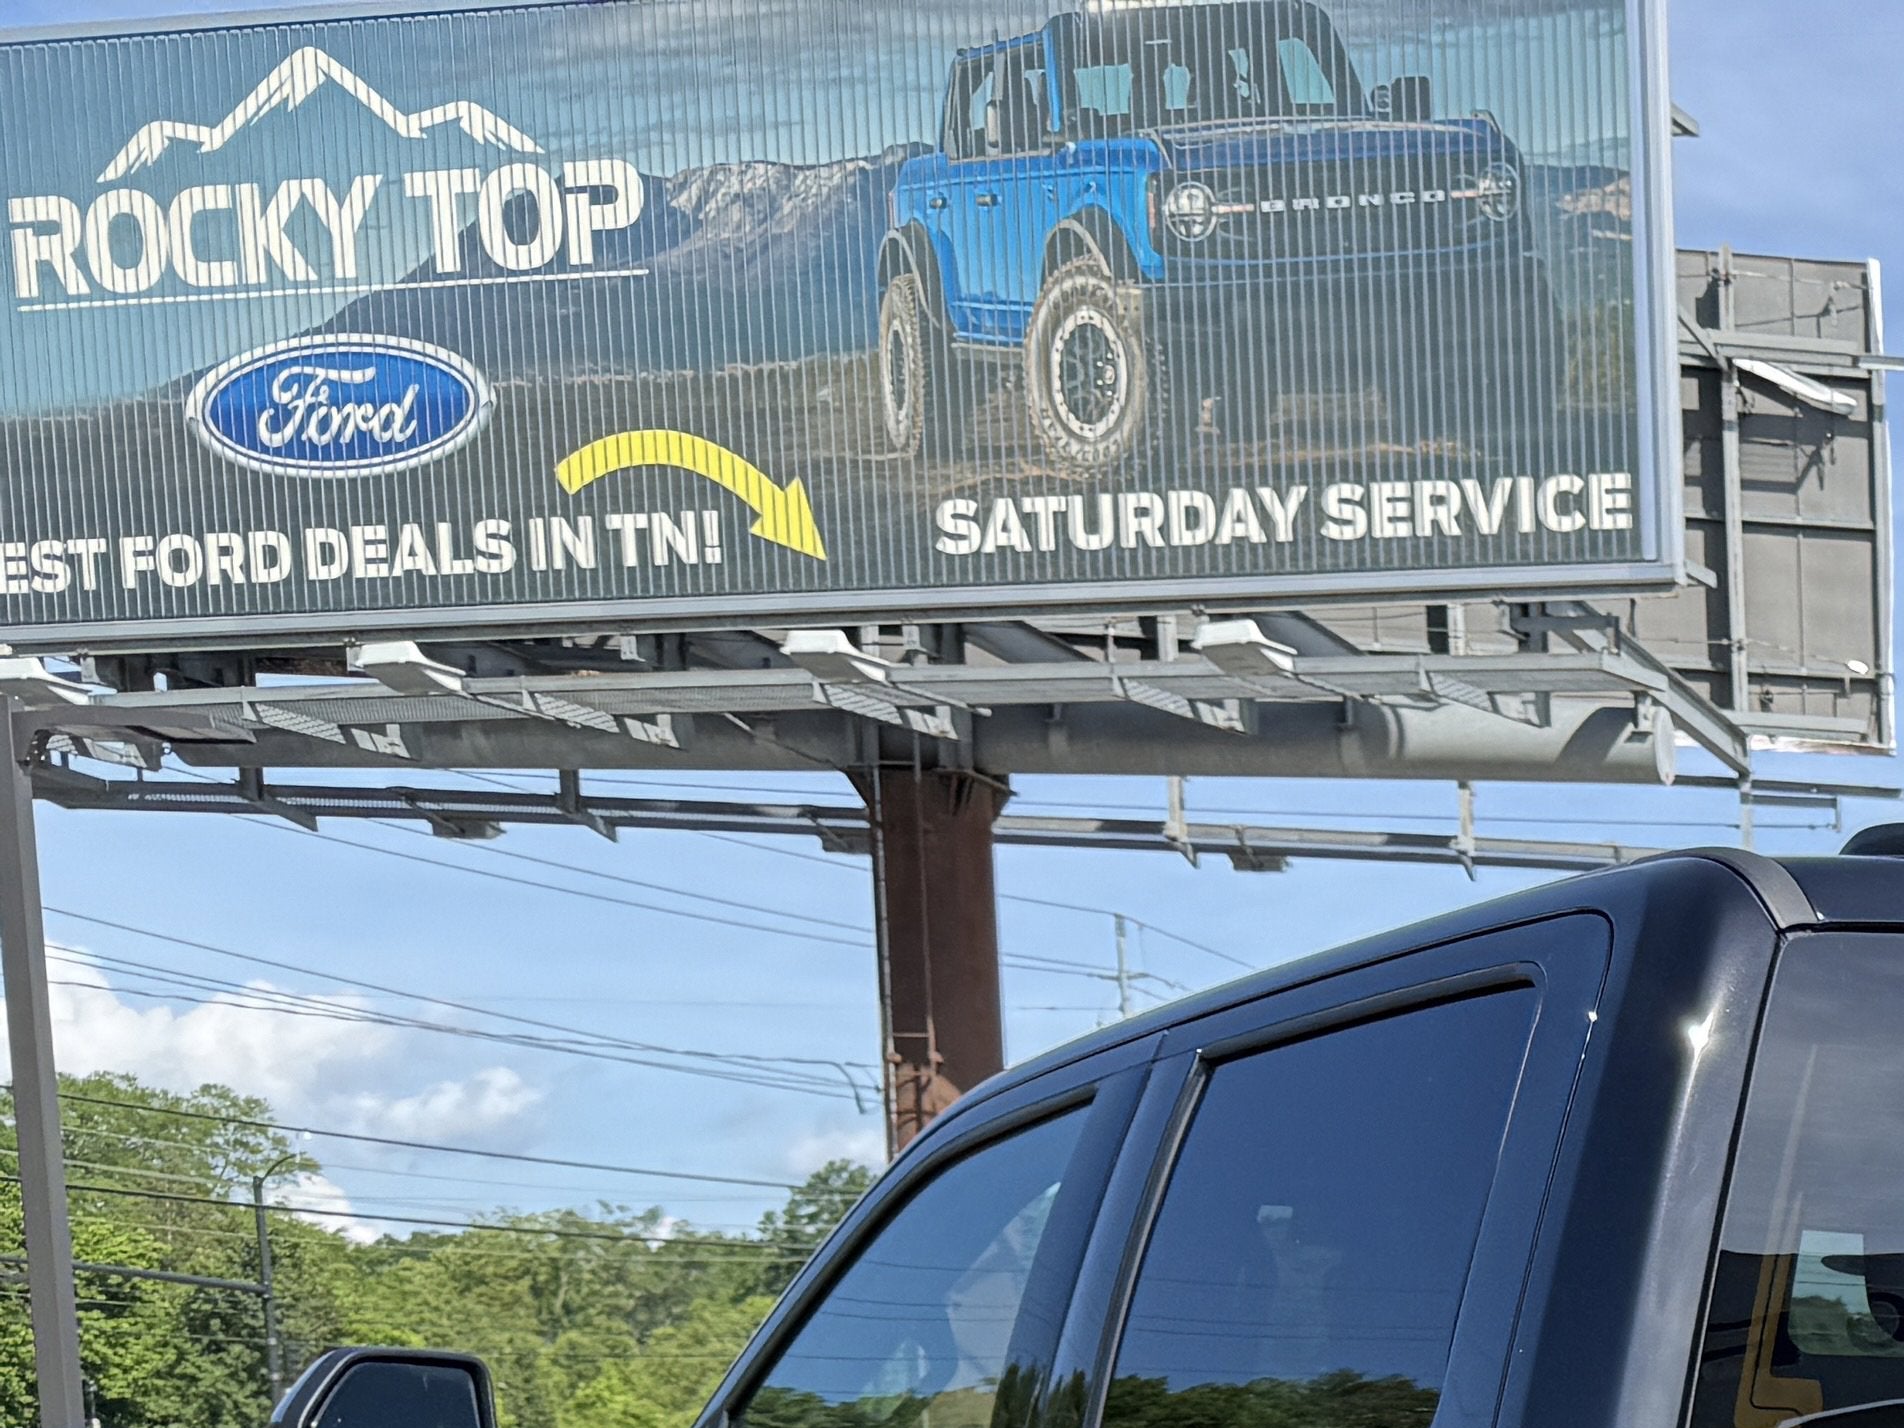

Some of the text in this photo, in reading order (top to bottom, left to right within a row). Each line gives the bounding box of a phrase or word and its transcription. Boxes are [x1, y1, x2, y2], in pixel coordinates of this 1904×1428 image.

[8, 158, 645, 299] ROCKY TOP
[1260, 190, 1446, 213] BRONCO
[257, 365, 420, 448] Ford
[119, 530, 292, 589] FORD
[304, 518, 517, 581] DEALS
[528, 515, 597, 571] IN
[605, 510, 722, 568] TN!
[934, 472, 1634, 555] SATURDAY SERVICE
